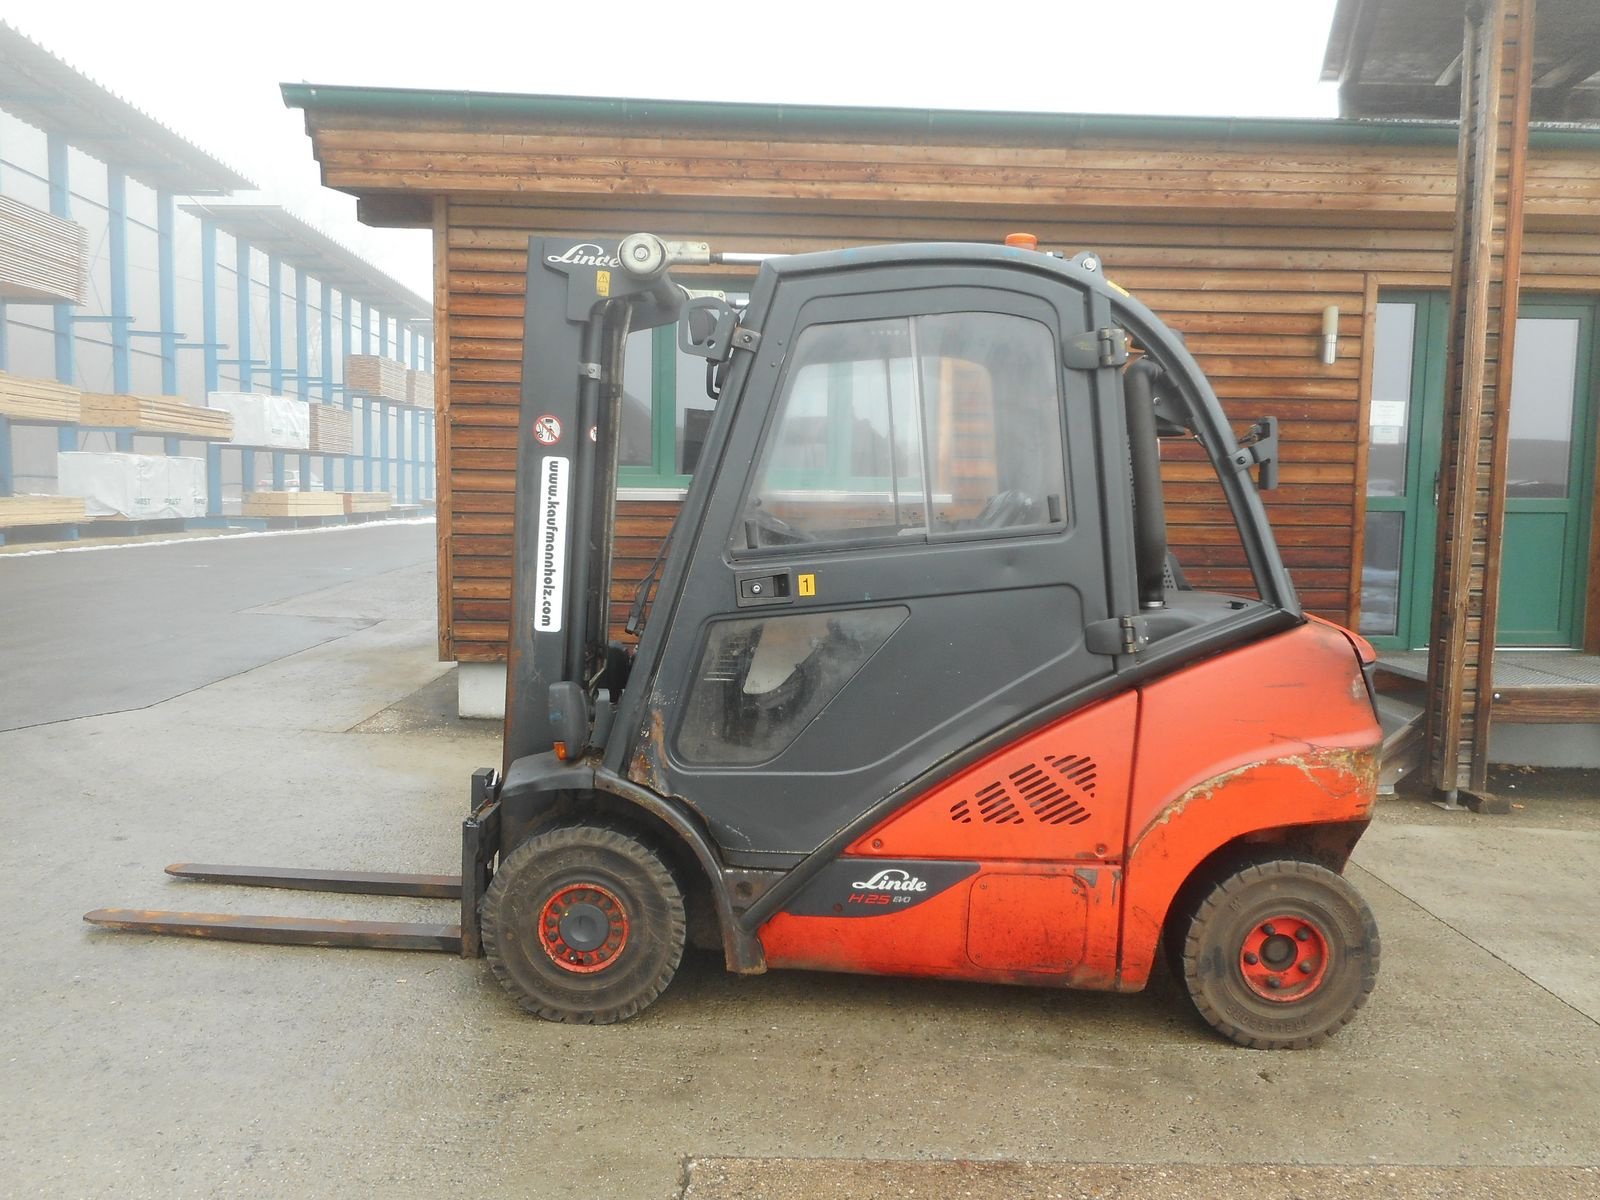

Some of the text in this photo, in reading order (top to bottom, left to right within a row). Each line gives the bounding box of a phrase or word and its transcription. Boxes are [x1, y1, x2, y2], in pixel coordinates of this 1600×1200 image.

[547, 243, 619, 268] Linde
[541, 459, 560, 627] www.kaufmannholz.com
[802, 577, 809, 593] 1
[852, 869, 927, 892] Linde
[892, 895, 911, 904] EVO
